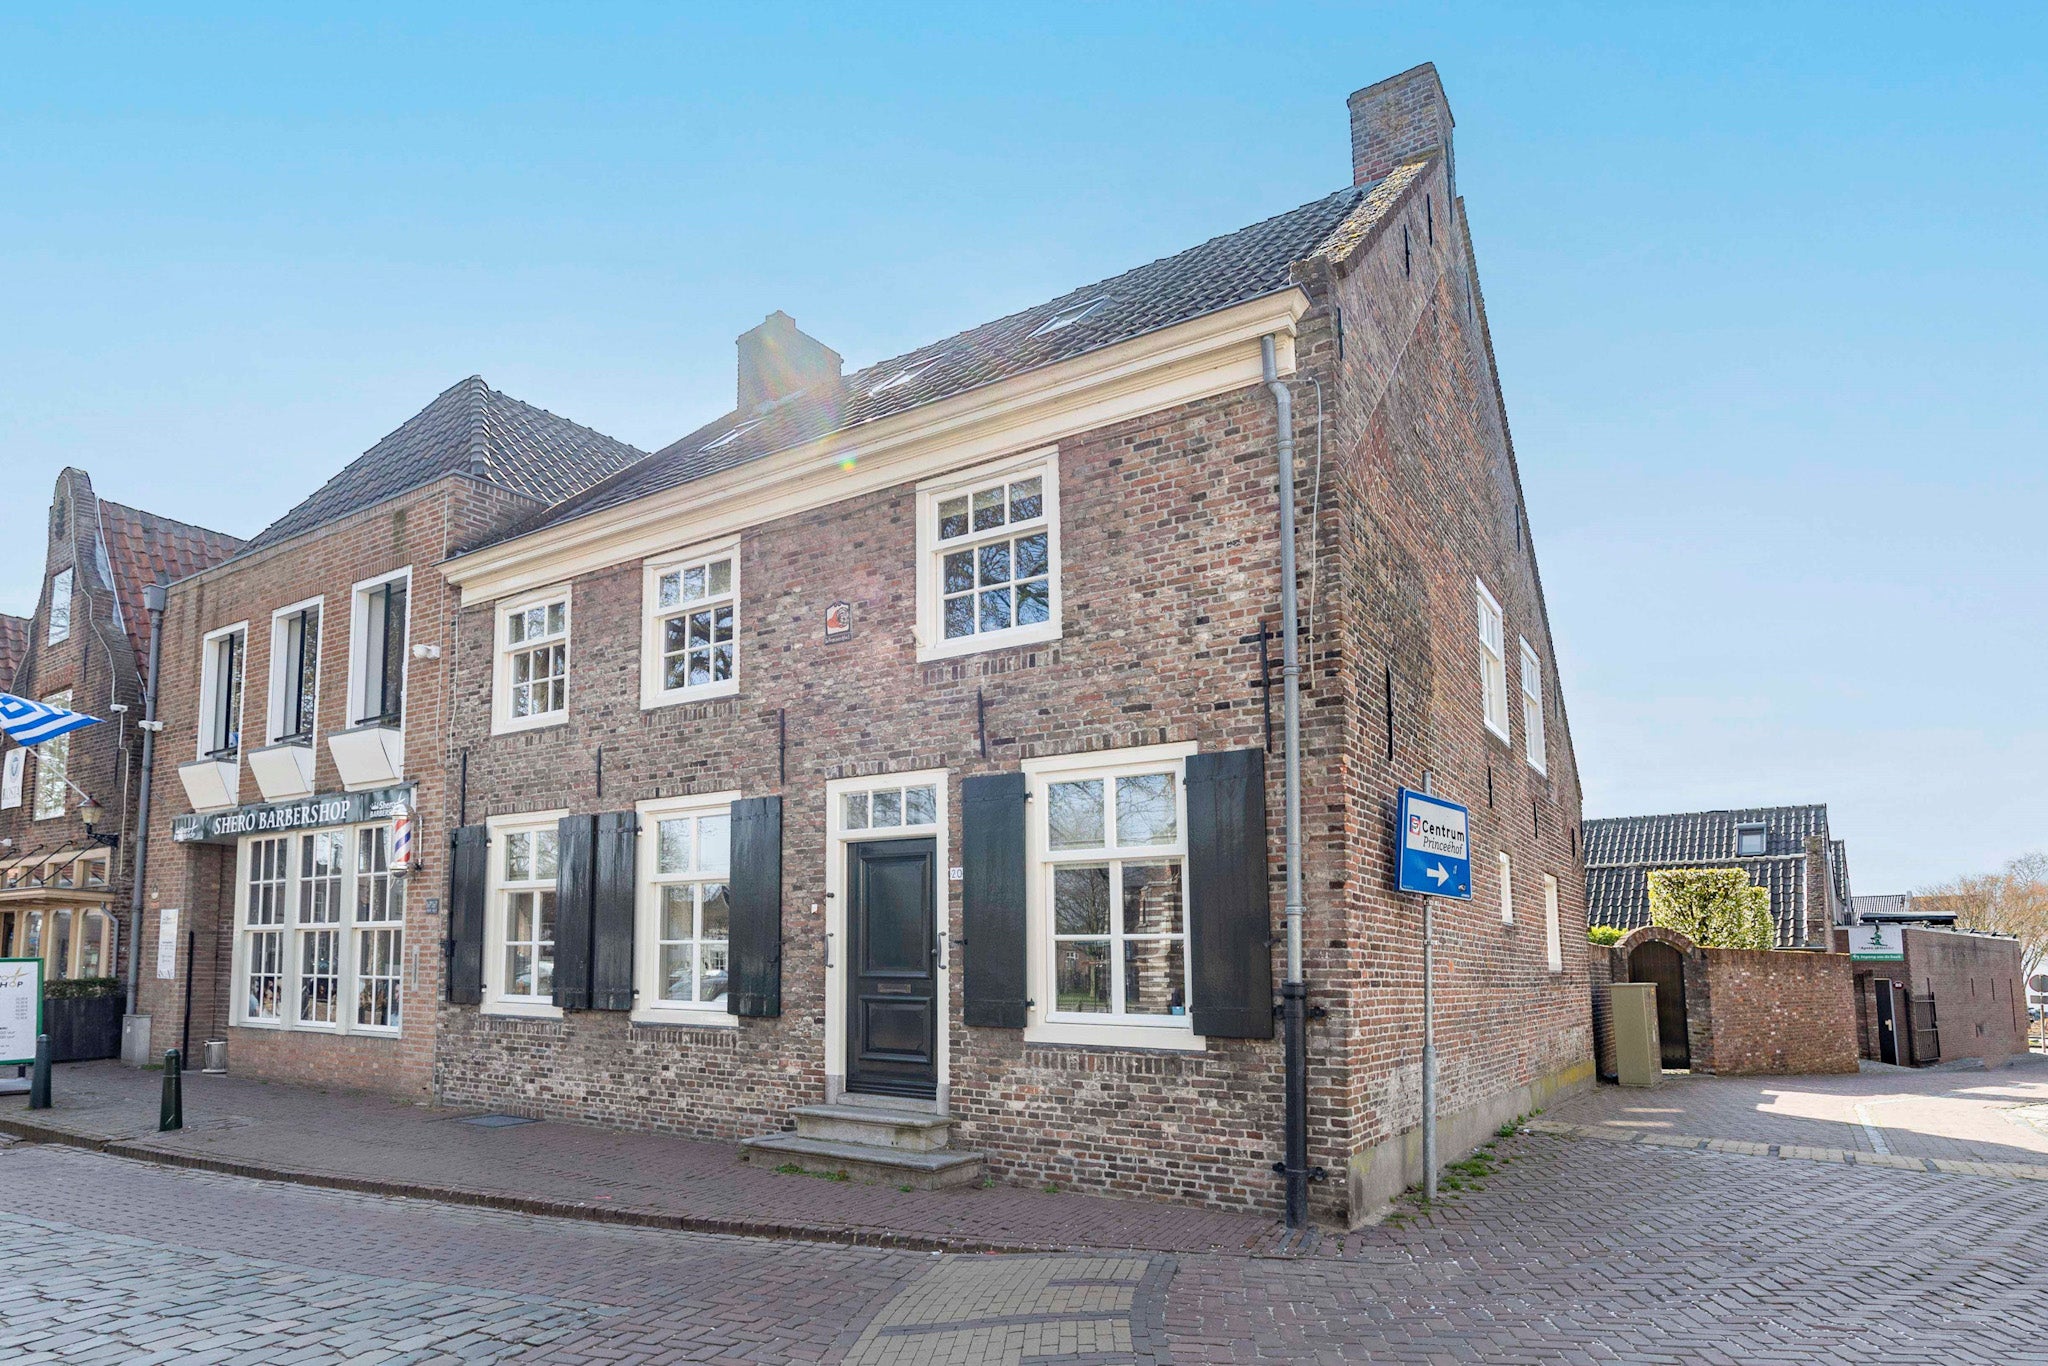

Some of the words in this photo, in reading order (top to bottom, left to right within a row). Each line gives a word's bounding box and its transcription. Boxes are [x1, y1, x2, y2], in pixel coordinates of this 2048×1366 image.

[214, 813, 256, 835] SHERO
[258, 800, 351, 830] BARBERSHOP
[1422, 820, 1465, 842] Centrum
[951, 869, 963, 879] 20
